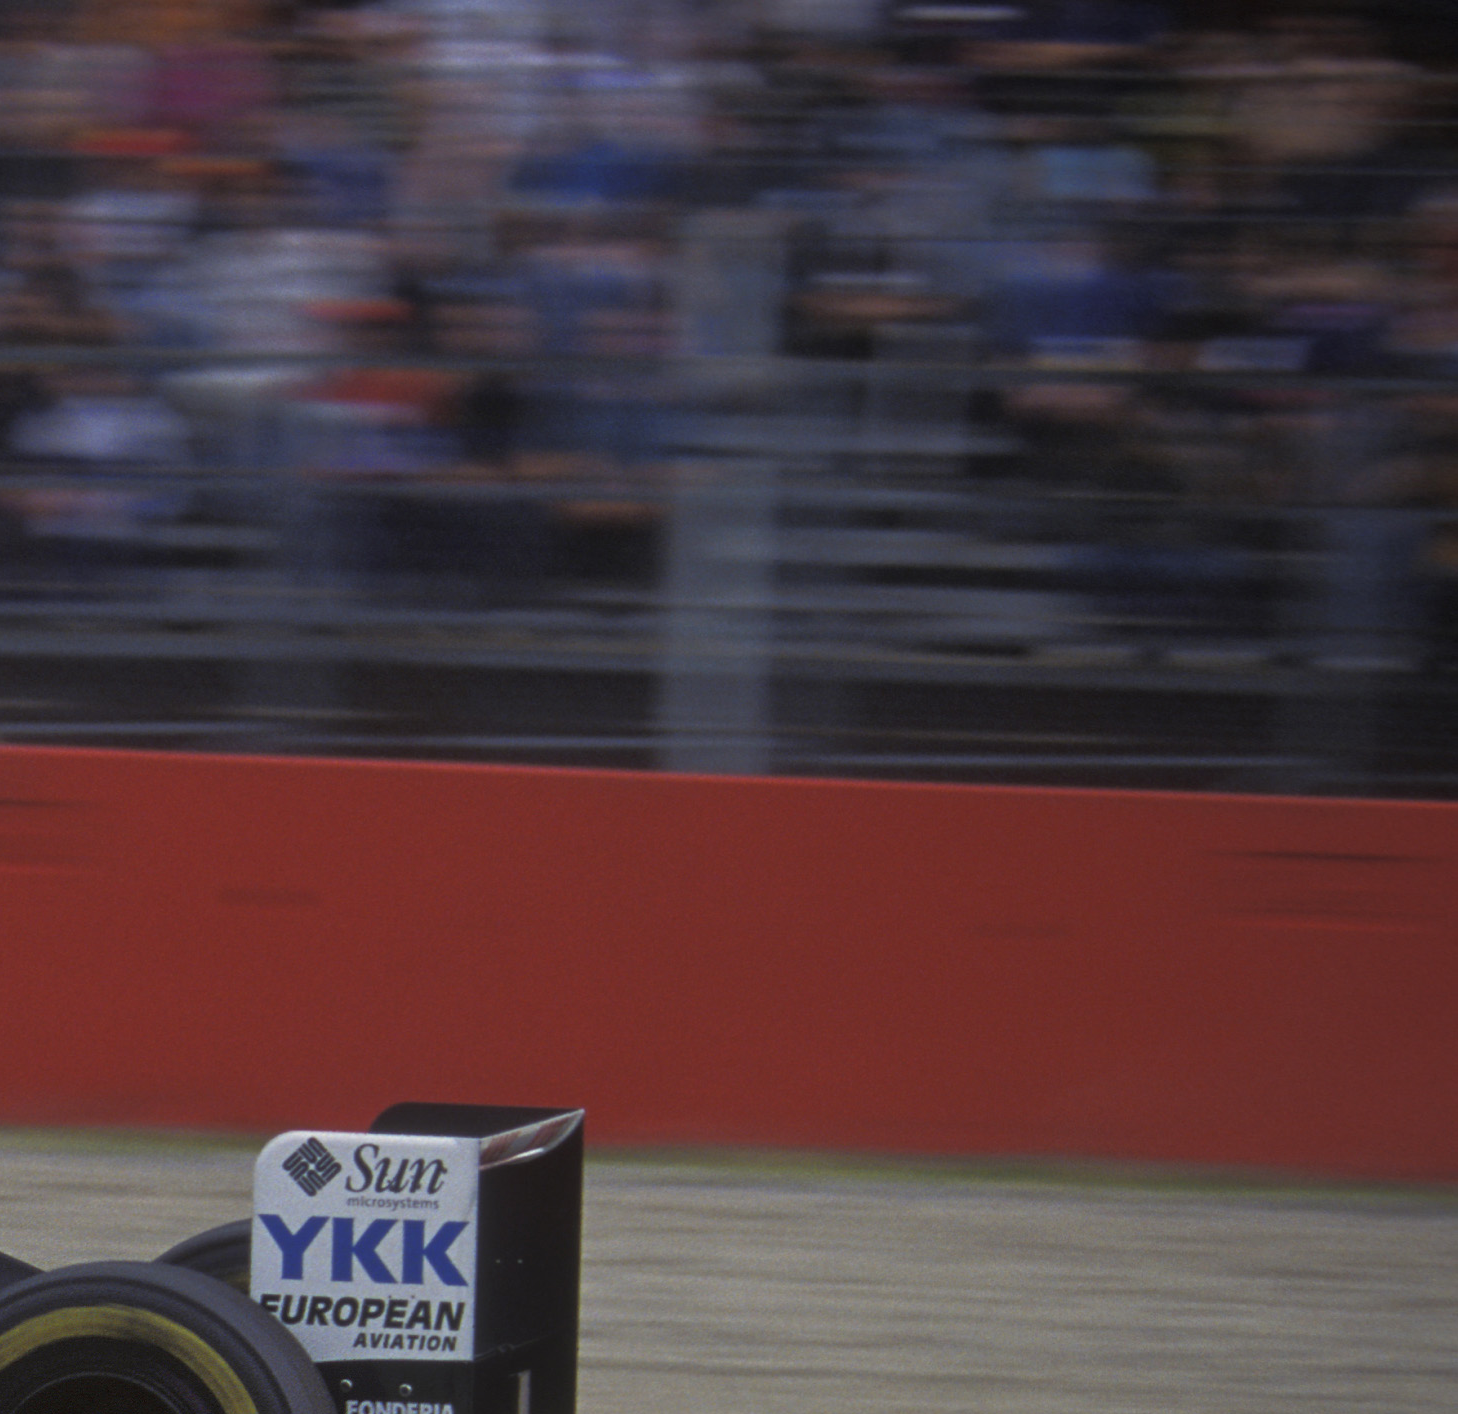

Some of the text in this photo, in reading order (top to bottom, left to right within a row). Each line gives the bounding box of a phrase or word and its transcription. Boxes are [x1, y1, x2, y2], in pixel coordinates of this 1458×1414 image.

[345, 1143, 448, 1194] Sun
[346, 1195, 440, 1212] microsystems
[258, 1213, 470, 1287] YKK
[259, 1294, 466, 1332] EUROPEAN
[353, 1332, 457, 1352] AVIATION
